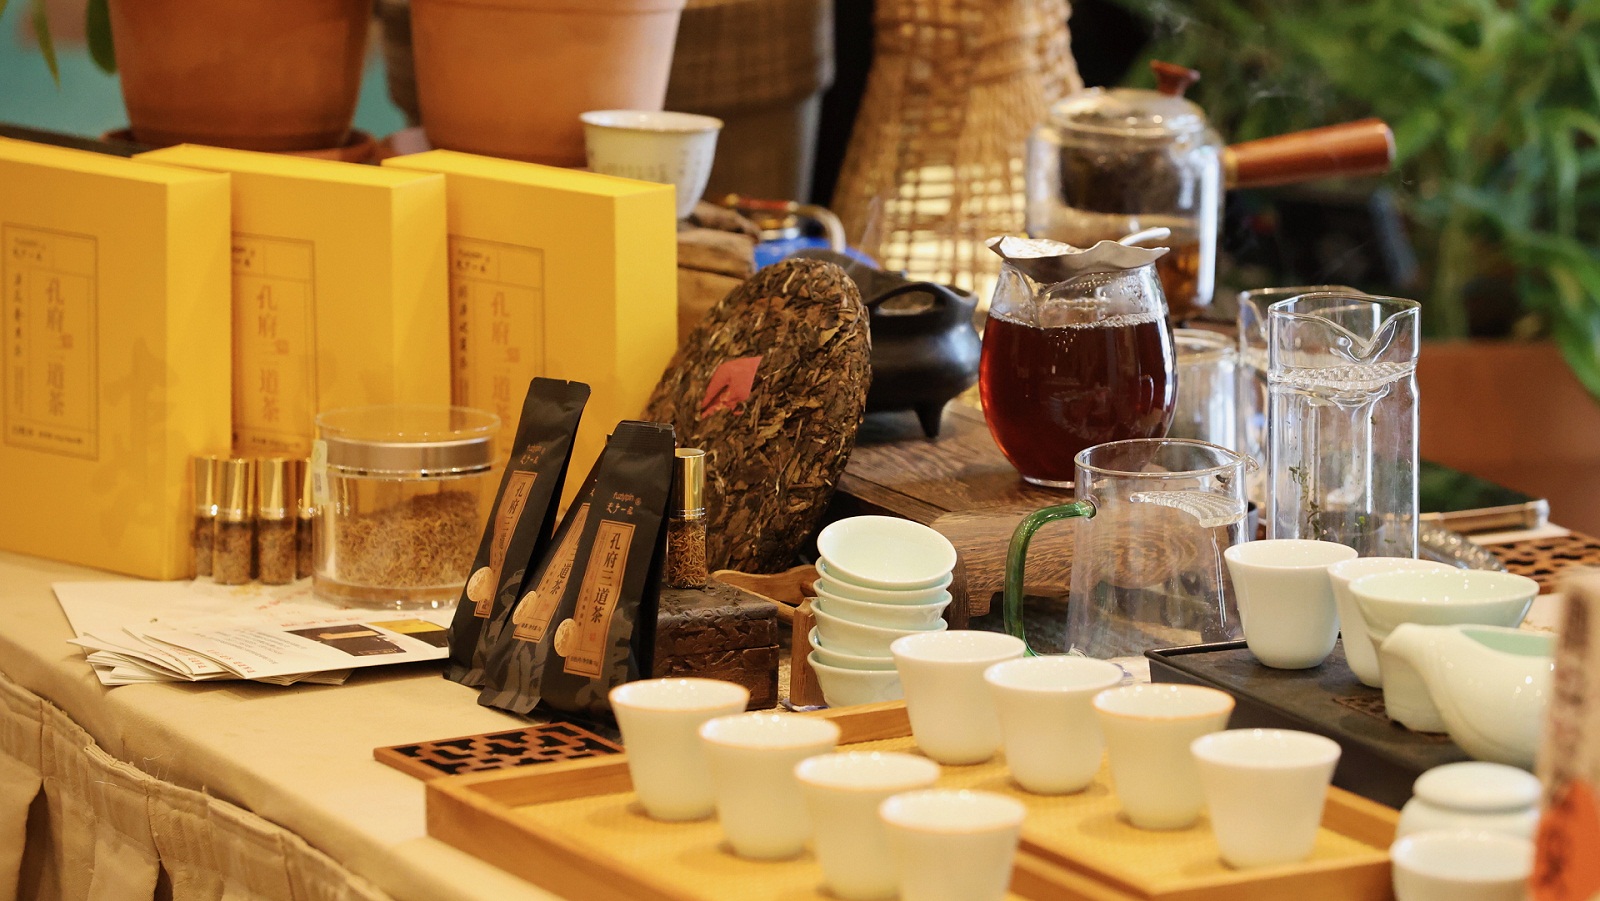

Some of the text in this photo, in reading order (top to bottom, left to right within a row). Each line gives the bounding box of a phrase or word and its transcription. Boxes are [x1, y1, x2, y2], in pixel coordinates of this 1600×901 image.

[590, 532, 622, 624] 孔府三道茶
